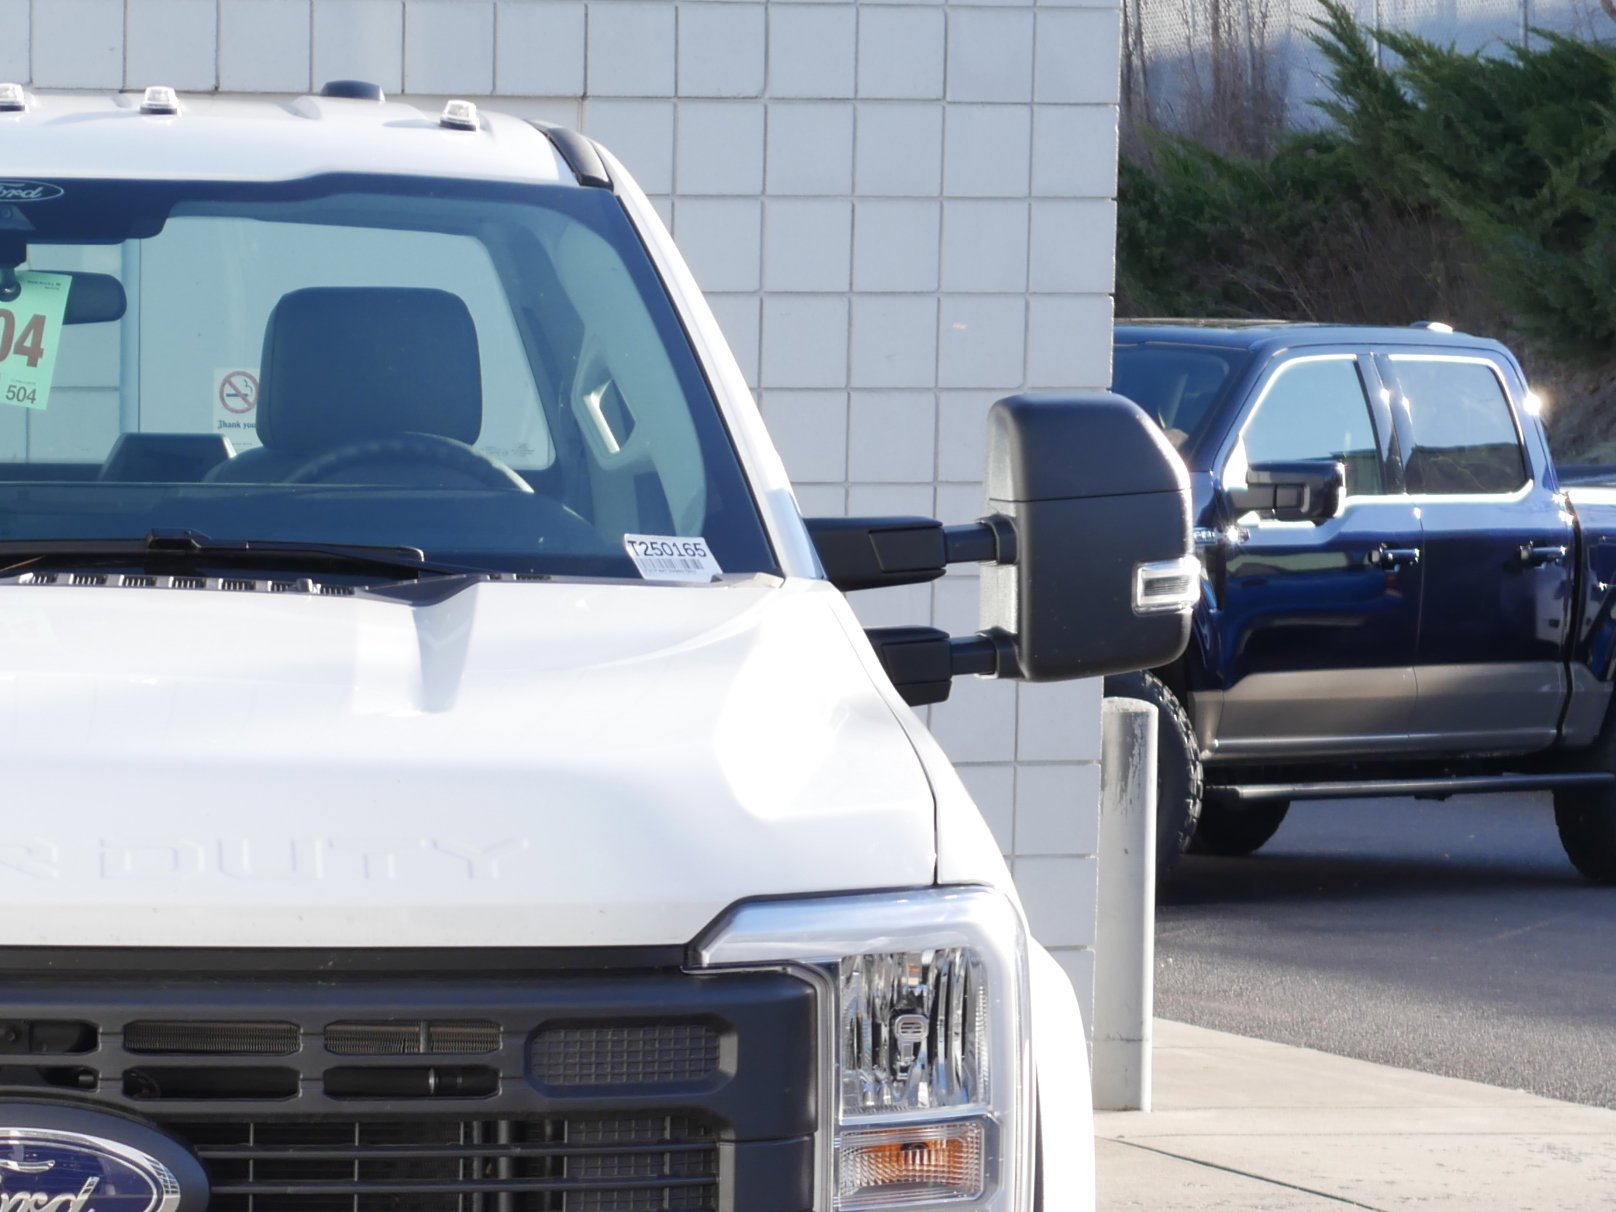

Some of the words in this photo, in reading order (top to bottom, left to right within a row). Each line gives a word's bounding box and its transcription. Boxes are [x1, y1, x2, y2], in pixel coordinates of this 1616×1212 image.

[5, 384, 37, 404] 504
[217, 420, 241, 429] Thank
[627, 540, 707, 558] T250165
[97, 835, 531, 882] DUTY
